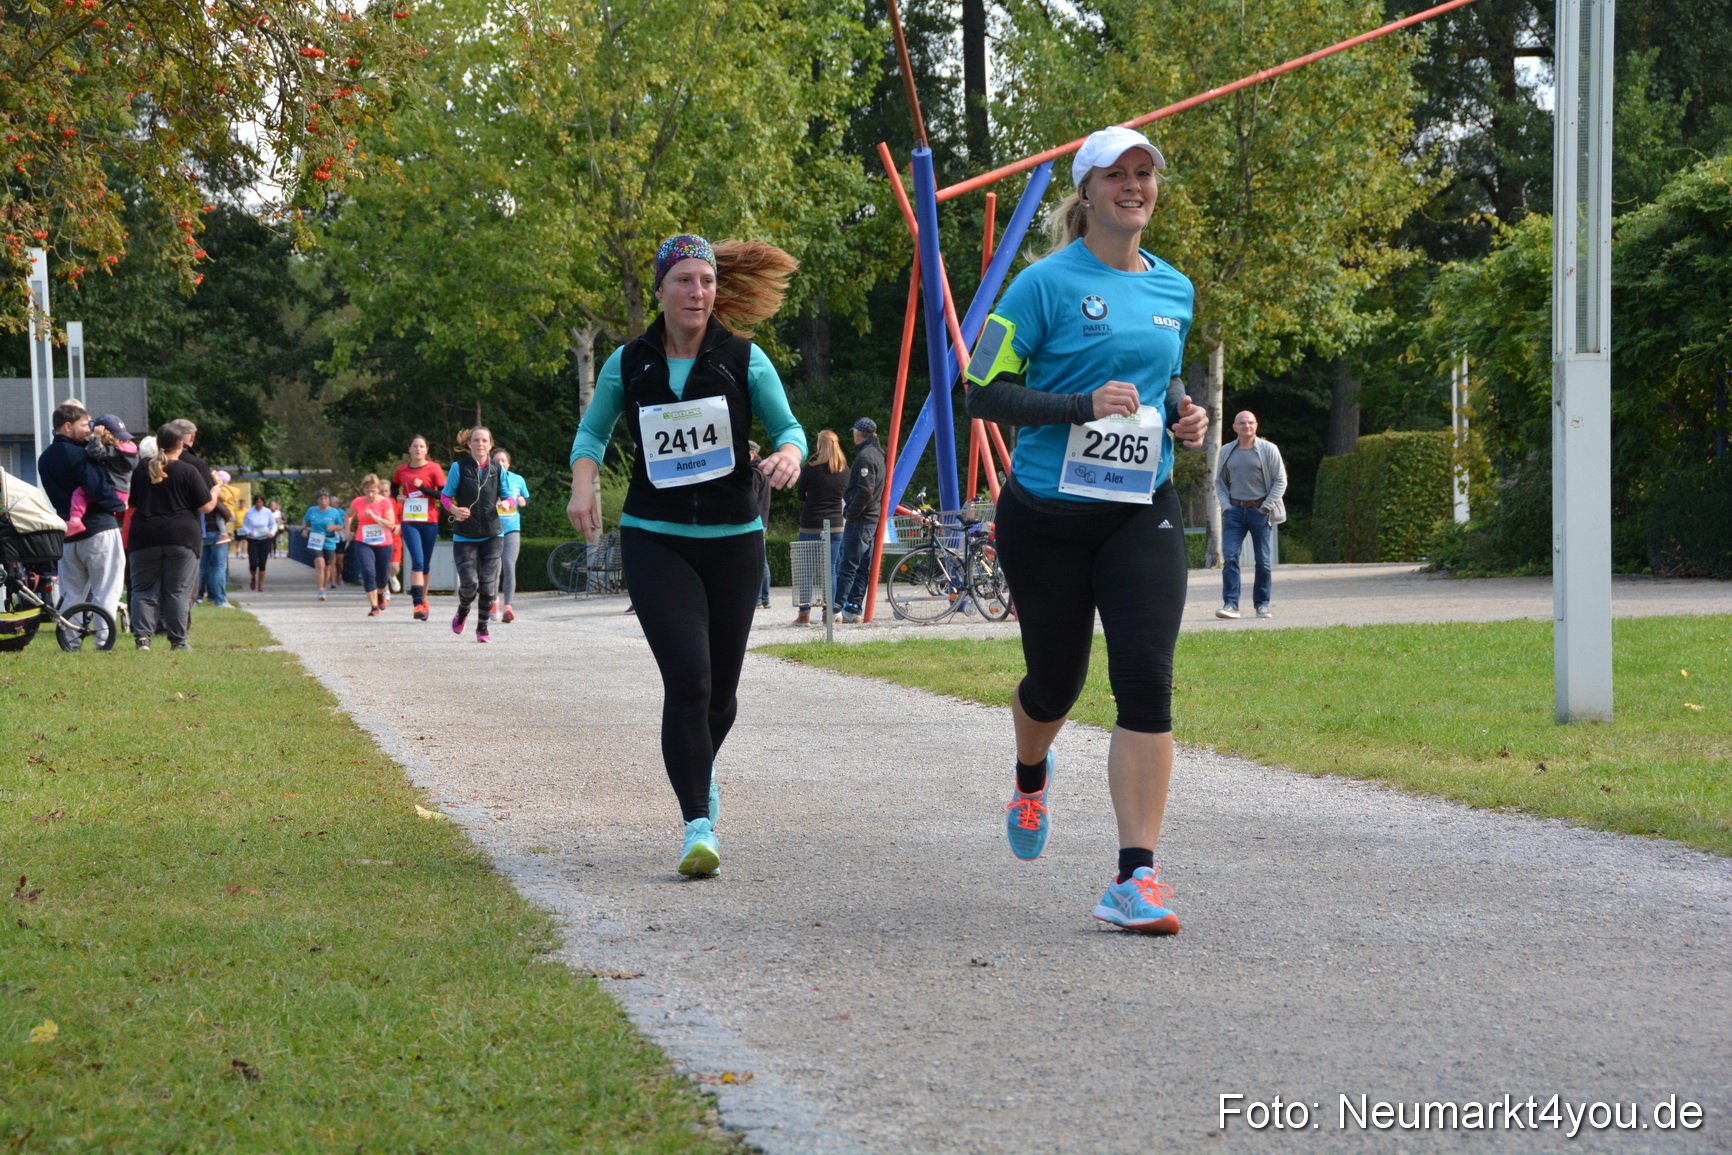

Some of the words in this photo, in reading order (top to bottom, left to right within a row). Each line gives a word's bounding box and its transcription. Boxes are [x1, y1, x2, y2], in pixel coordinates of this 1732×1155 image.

[655, 424, 718, 455] 2414
[1082, 430, 1149, 464] 2265
[676, 459, 707, 471] Andrea
[1104, 472, 1124, 484] Alex
[409, 504, 422, 512] 100
[365, 529, 382, 537] 2523
